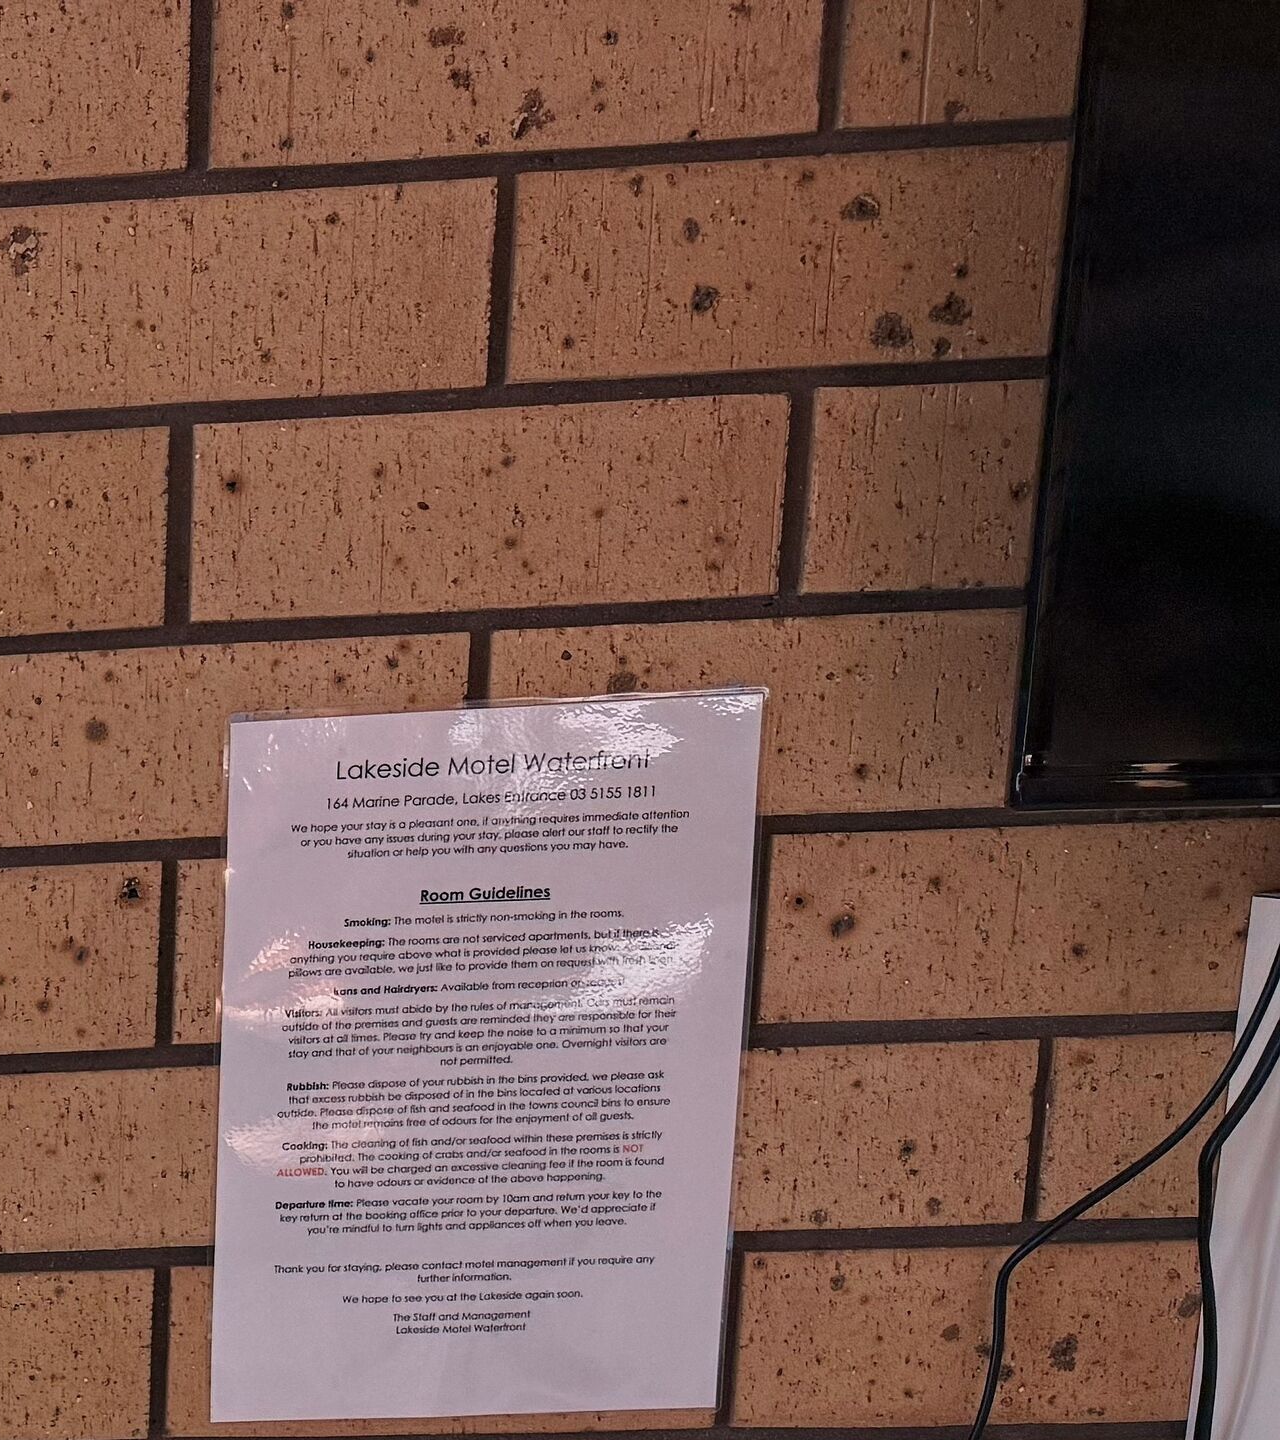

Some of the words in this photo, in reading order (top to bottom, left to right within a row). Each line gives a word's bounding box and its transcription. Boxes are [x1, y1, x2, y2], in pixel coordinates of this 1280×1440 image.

[336, 758, 440, 780] Lakeside
[448, 754, 516, 777] Motel
[524, 750, 651, 772] Waterfront
[327, 796, 349, 810] 164
[352, 794, 400, 809] Marine
[403, 792, 458, 809] Parade,
[462, 792, 500, 804] Lakes
[569, 788, 587, 801] 03
[589, 786, 622, 800] 5155
[627, 784, 655, 799] 1811
[290, 824, 308, 834] We
[310, 822, 338, 835] hope
[340, 823, 364, 834] your
[365, 821, 387, 833] stay
[388, 820, 396, 830] is
[398, 822, 407, 830] a
[408, 818, 454, 832] pleasant
[456, 819, 480, 830] one,
[641, 809, 690, 820] attention
[300, 839, 311, 847] or
[312, 838, 334, 848] you
[334, 835, 362, 845] have
[363, 836, 385, 847] any
[386, 833, 415, 843] issues
[416, 832, 451, 845] during
[452, 833, 476, 843] your
[503, 829, 540, 842] please
[541, 828, 566, 838] alert
[567, 829, 586, 837] our
[586, 826, 610, 836] staff
[612, 826, 624, 835] to
[624, 824, 659, 837] rectify
[660, 824, 679, 834] the
[420, 889, 464, 902] Room
[469, 886, 551, 900] Guidelines
[343, 917, 392, 930] Smoking:
[393, 916, 412, 926] The
[414, 915, 445, 925] motel
[446, 914, 454, 924] is
[455, 913, 488, 926] strictly
[489, 911, 556, 925] non-smoking
[557, 911, 568, 920] in
[569, 910, 588, 920] the
[589, 911, 624, 919] rooms.
[273, 1264, 304, 1274] Thank
[305, 1265, 326, 1275] you
[327, 1263, 342, 1272] for
[384, 1261, 420, 1273] please
[421, 1260, 464, 1270] contact
[464, 1259, 495, 1269] motel
[496, 1257, 567, 1271] management
[568, 1257, 575, 1267] if
[576, 1258, 596, 1269] you
[597, 1256, 634, 1268] require
[635, 1257, 655, 1267] any
[417, 1273, 451, 1283] further
[451, 1271, 512, 1282] information.
[342, 1294, 359, 1304] We
[361, 1293, 389, 1306] hope
[391, 1293, 402, 1303] to
[403, 1294, 423, 1302] see
[424, 1294, 444, 1304] you
[445, 1292, 457, 1301] at
[459, 1291, 477, 1301] the
[478, 1290, 523, 1300] Lakeside
[524, 1289, 555, 1302] again
[556, 1290, 583, 1299] soon.
[392, 1312, 411, 1322] The
[412, 1312, 436, 1322] Staff
[437, 1311, 460, 1321] and
[395, 1324, 440, 1335] Lakeside
[442, 1323, 472, 1333] Motel
[473, 1321, 526, 1332] Waterfront
